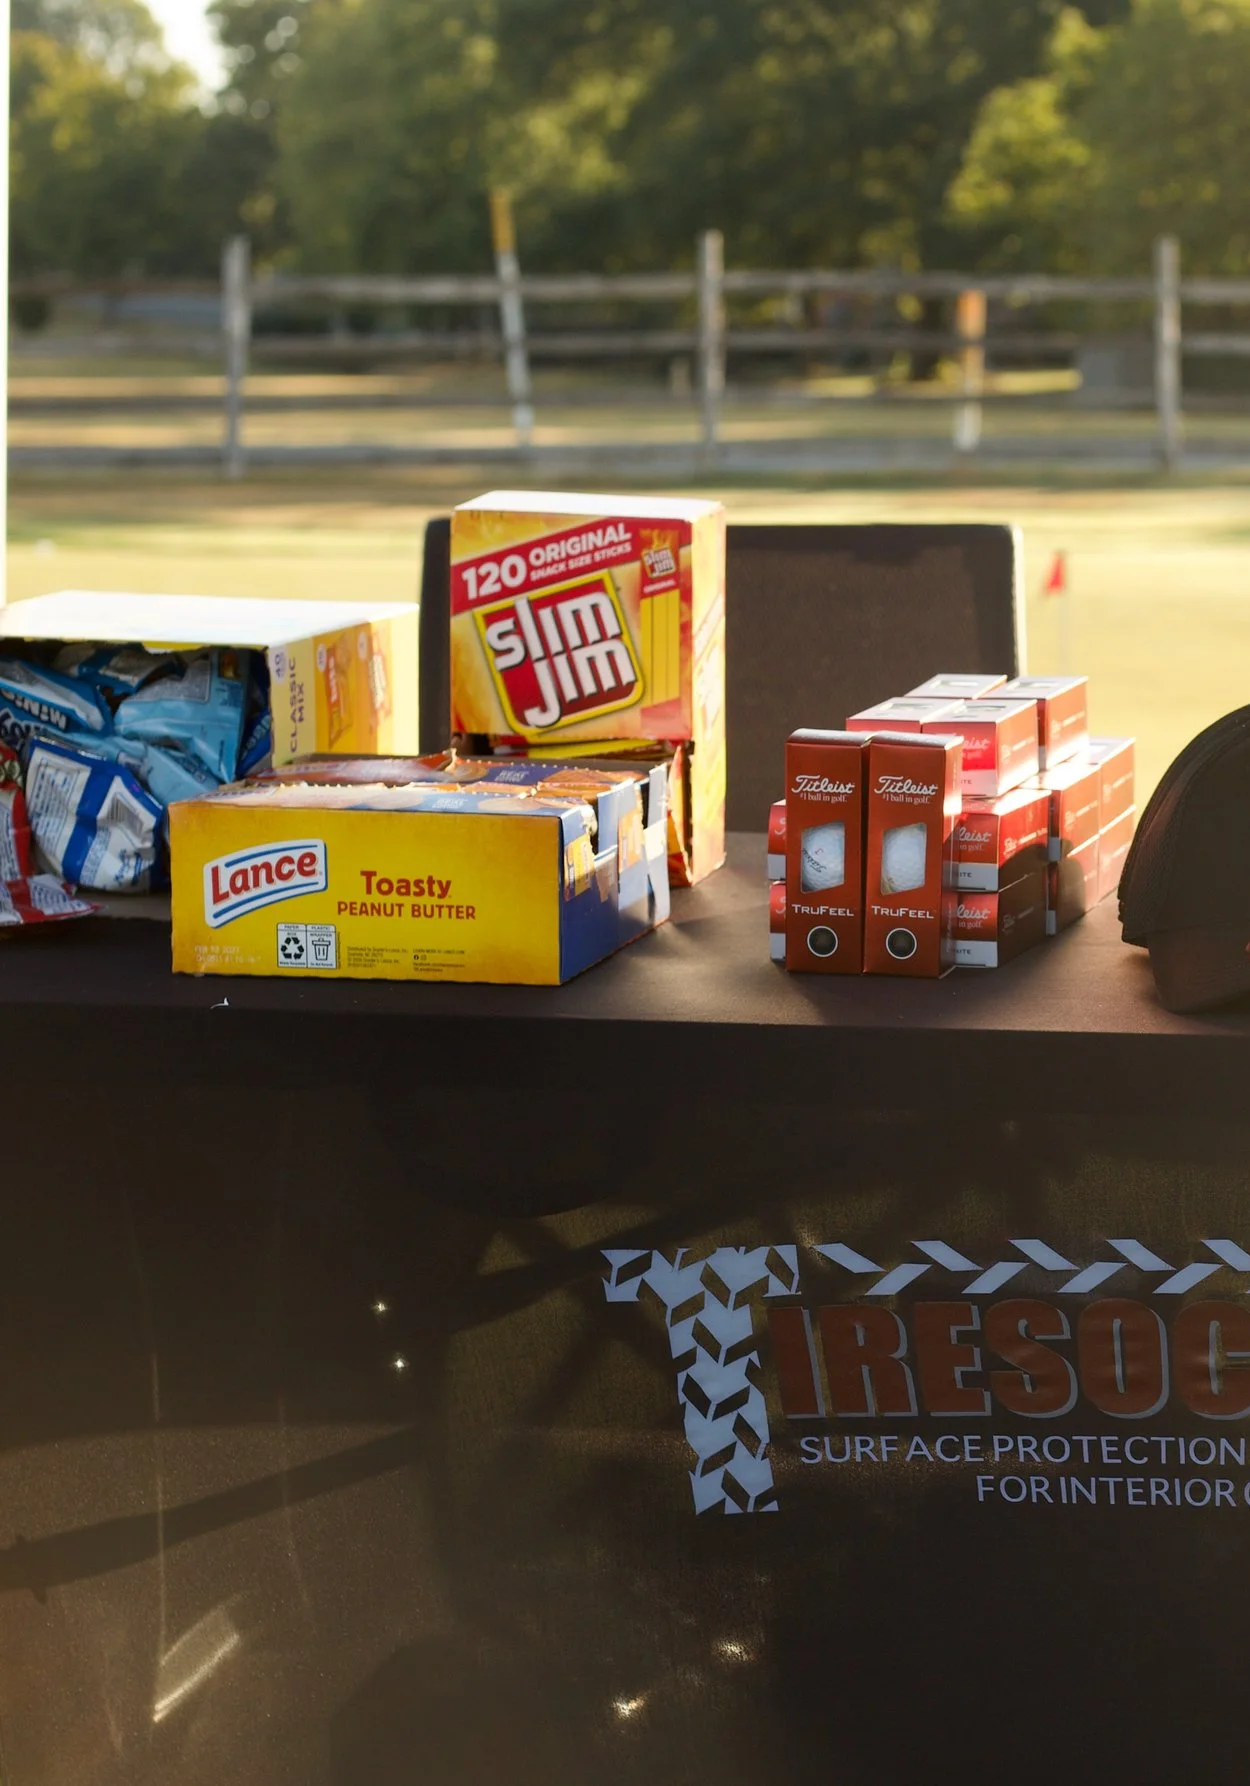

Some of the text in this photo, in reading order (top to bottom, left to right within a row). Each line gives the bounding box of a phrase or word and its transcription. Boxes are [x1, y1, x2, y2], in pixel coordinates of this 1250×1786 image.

[528, 522, 632, 567] ORIGINAL
[530, 541, 632, 581] SNACK SIZE STICKS
[462, 554, 527, 600] 120
[288, 656, 299, 753] CLASSIC
[296, 683, 305, 724] MIX
[791, 774, 856, 793] Titleist
[808, 792, 822, 801] ball
[822, 794, 831, 802] in
[873, 775, 939, 796] Titleist
[890, 794, 904, 802] ball
[905, 795, 913, 803] in
[211, 851, 318, 905] Lance
[360, 870, 452, 899] Toasty
[337, 901, 476, 920] PEANUT BUTTER
[800, 1435, 984, 1464] SURFACE
[992, 1435, 1246, 1466] PROTECTION
[976, 1475, 1053, 1503] FOR
[1059, 1476, 1236, 1507] INTERIOR
